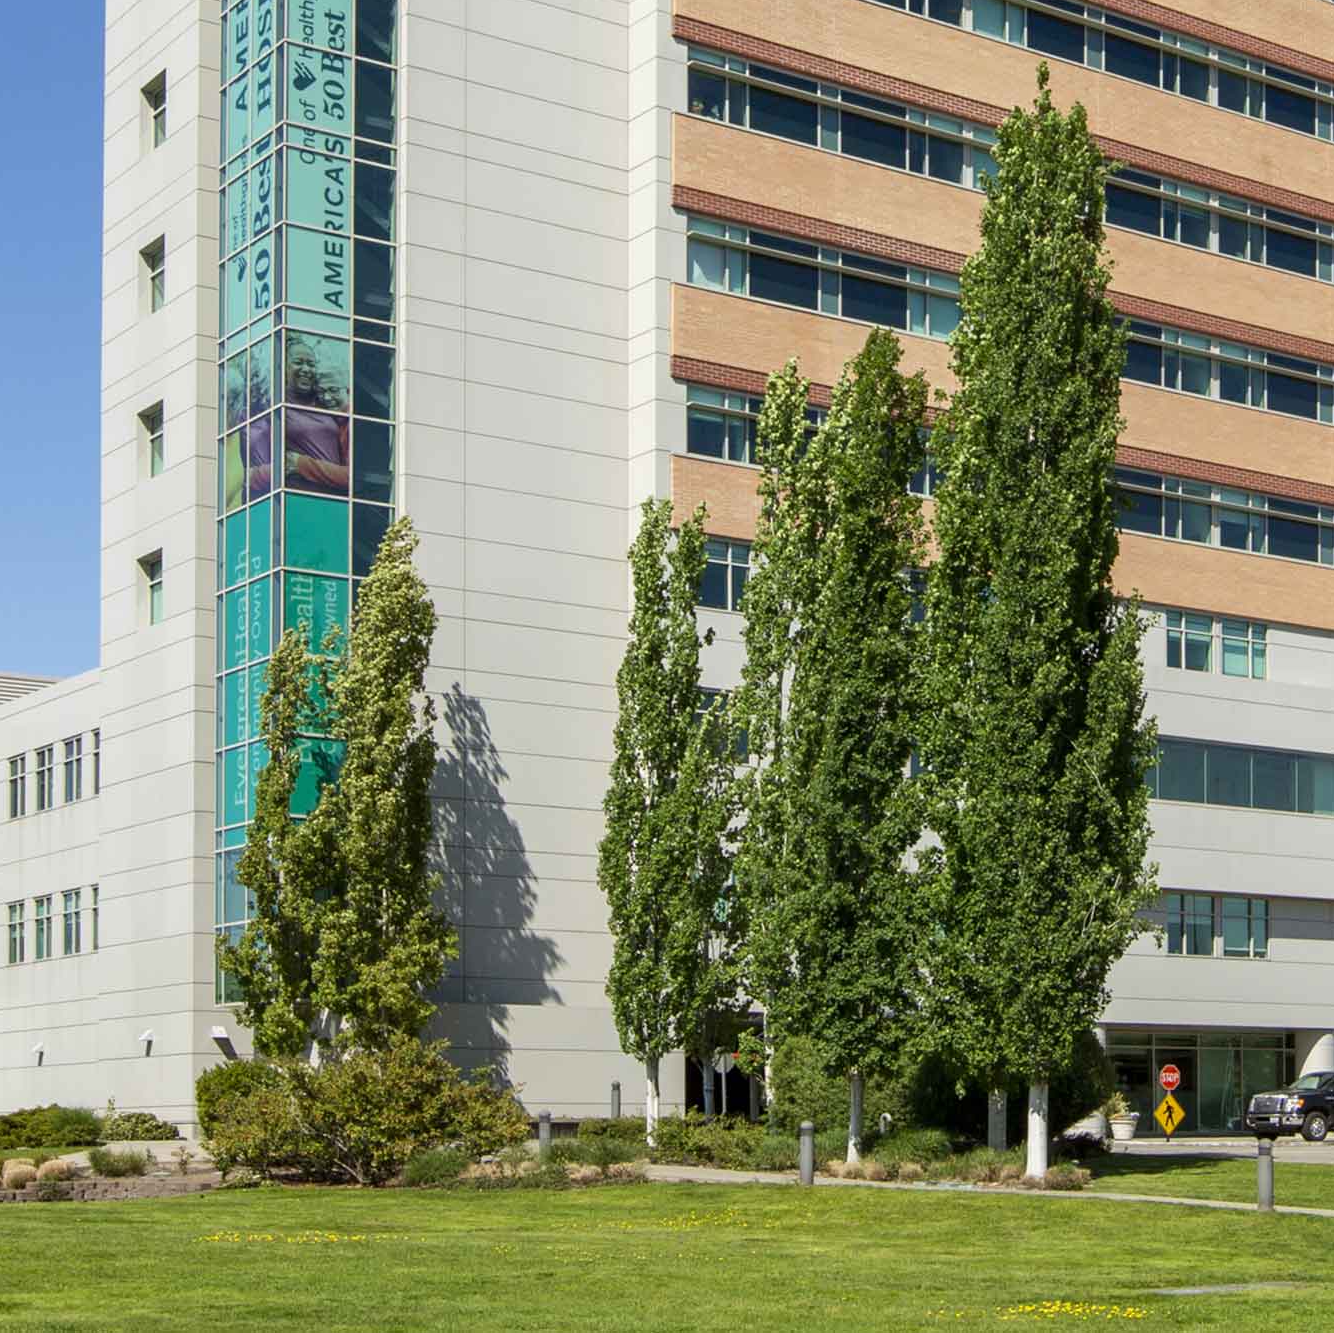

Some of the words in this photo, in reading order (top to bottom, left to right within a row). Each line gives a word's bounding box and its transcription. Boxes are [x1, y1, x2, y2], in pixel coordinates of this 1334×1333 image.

[321, 10, 346, 76] Best
[298, 98, 316, 121] of
[322, 79, 346, 121] 50
[300, 127, 316, 165] One
[254, 136, 271, 237] Best
[323, 137, 345, 311] AMERICA'S
[254, 248, 271, 310] 50
[250, 556, 264, 786] Community-Ownd
[1161, 1072, 1179, 1083] STOP
